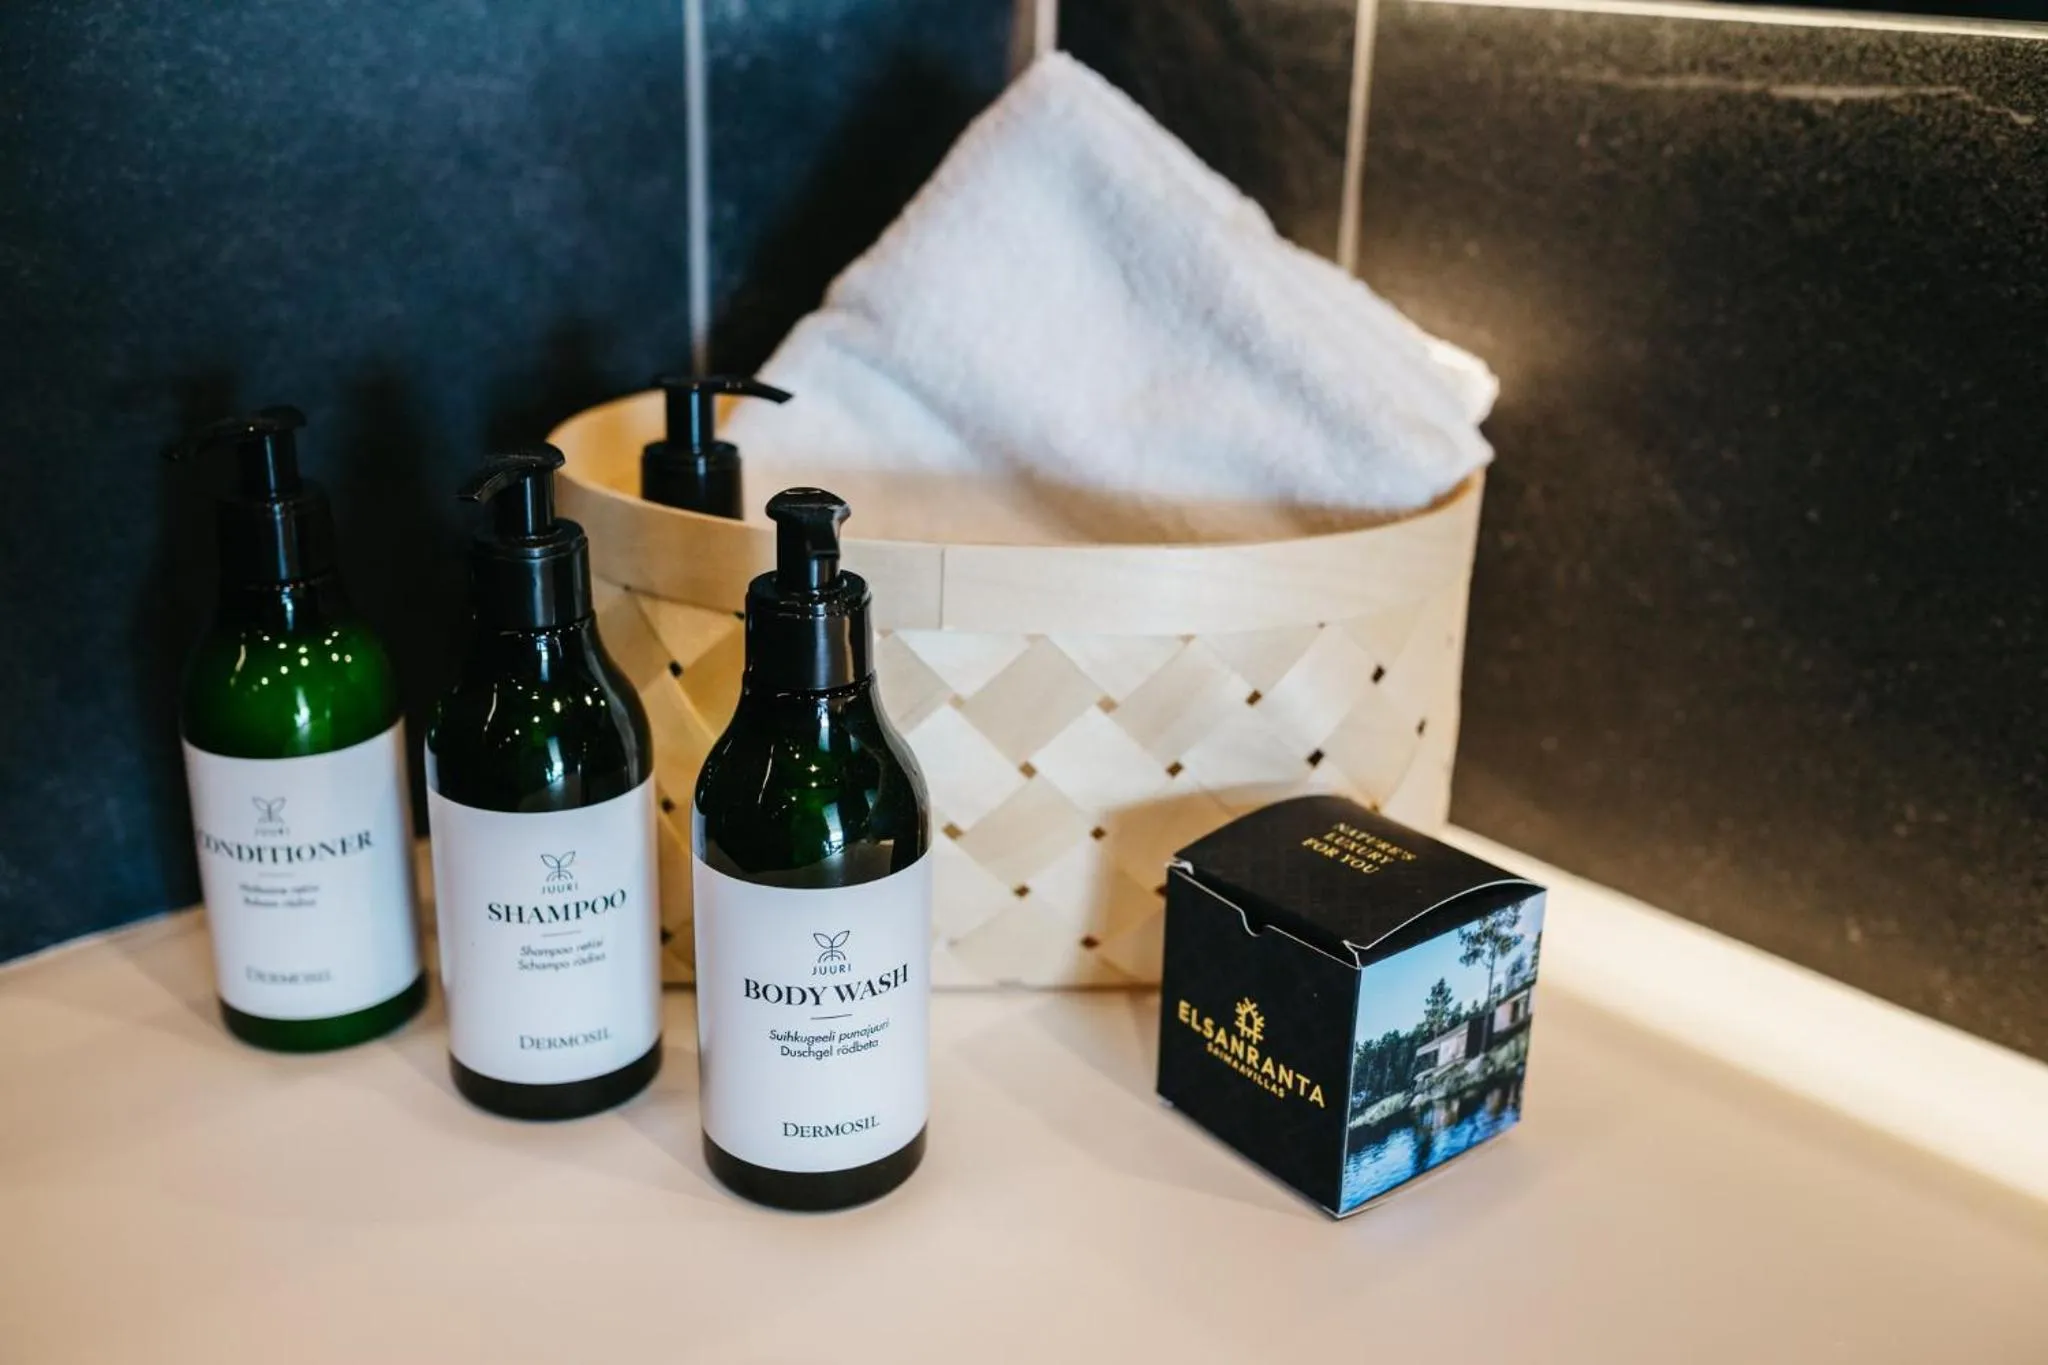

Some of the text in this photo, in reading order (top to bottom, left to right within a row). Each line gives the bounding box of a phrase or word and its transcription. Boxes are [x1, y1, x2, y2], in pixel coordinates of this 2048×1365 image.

[1302, 837, 1380, 873] FOR YOU
[1323, 832, 1394, 863] LUXURY
[487, 888, 627, 924] SHAMPOO
[744, 963, 908, 1006] BODY WASH
[812, 963, 851, 976] JUURI
[519, 1027, 612, 1050] DERMOSIL
[769, 1018, 890, 1046] Suihkugeeli punajuuri
[780, 1040, 879, 1060] Duschgel rödbeta
[1178, 1000, 1325, 1108] ELSANRANTA
[1206, 1042, 1285, 1099] SAIMAAVILLAS
[783, 1116, 880, 1138] DERMOSIL
